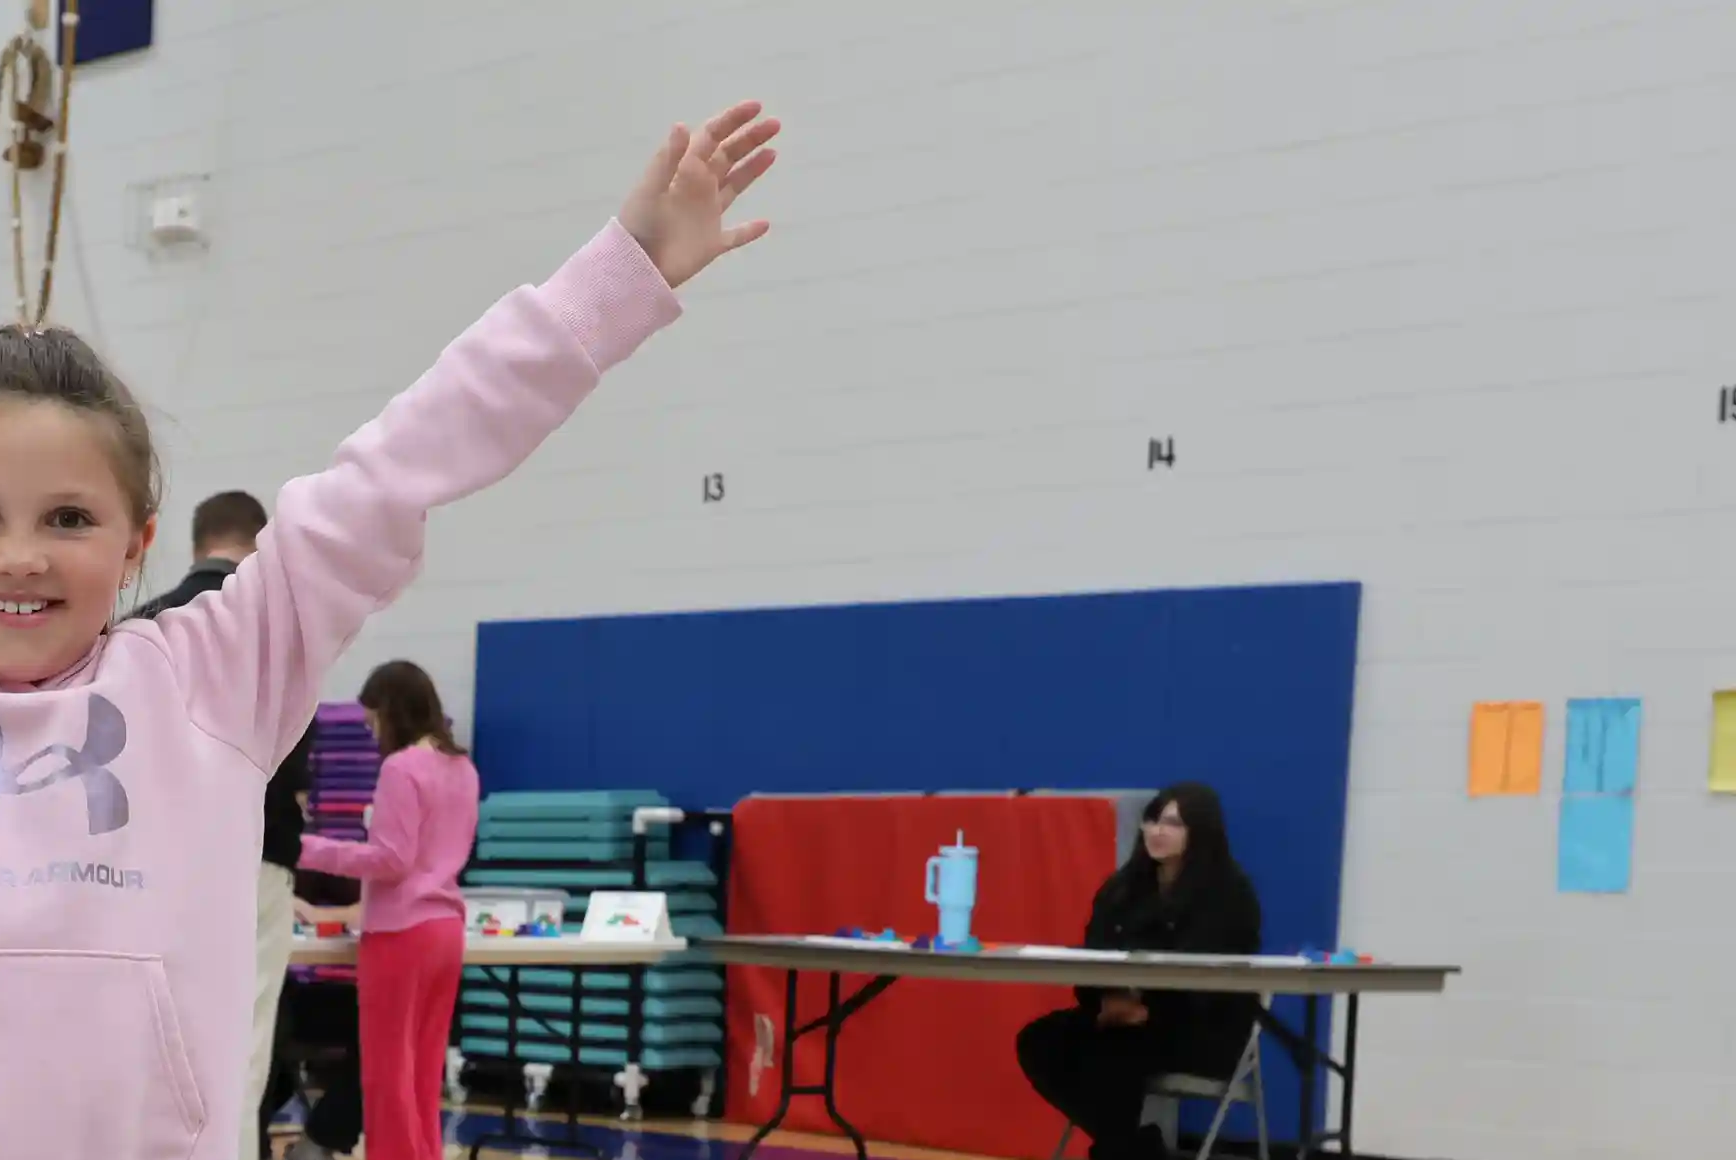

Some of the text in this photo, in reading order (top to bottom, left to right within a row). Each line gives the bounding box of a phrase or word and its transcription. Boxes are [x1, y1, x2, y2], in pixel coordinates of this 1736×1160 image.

[1147, 435, 1176, 471] 14
[702, 472, 726, 504] 13
[22, 861, 146, 889] ARMOUR
